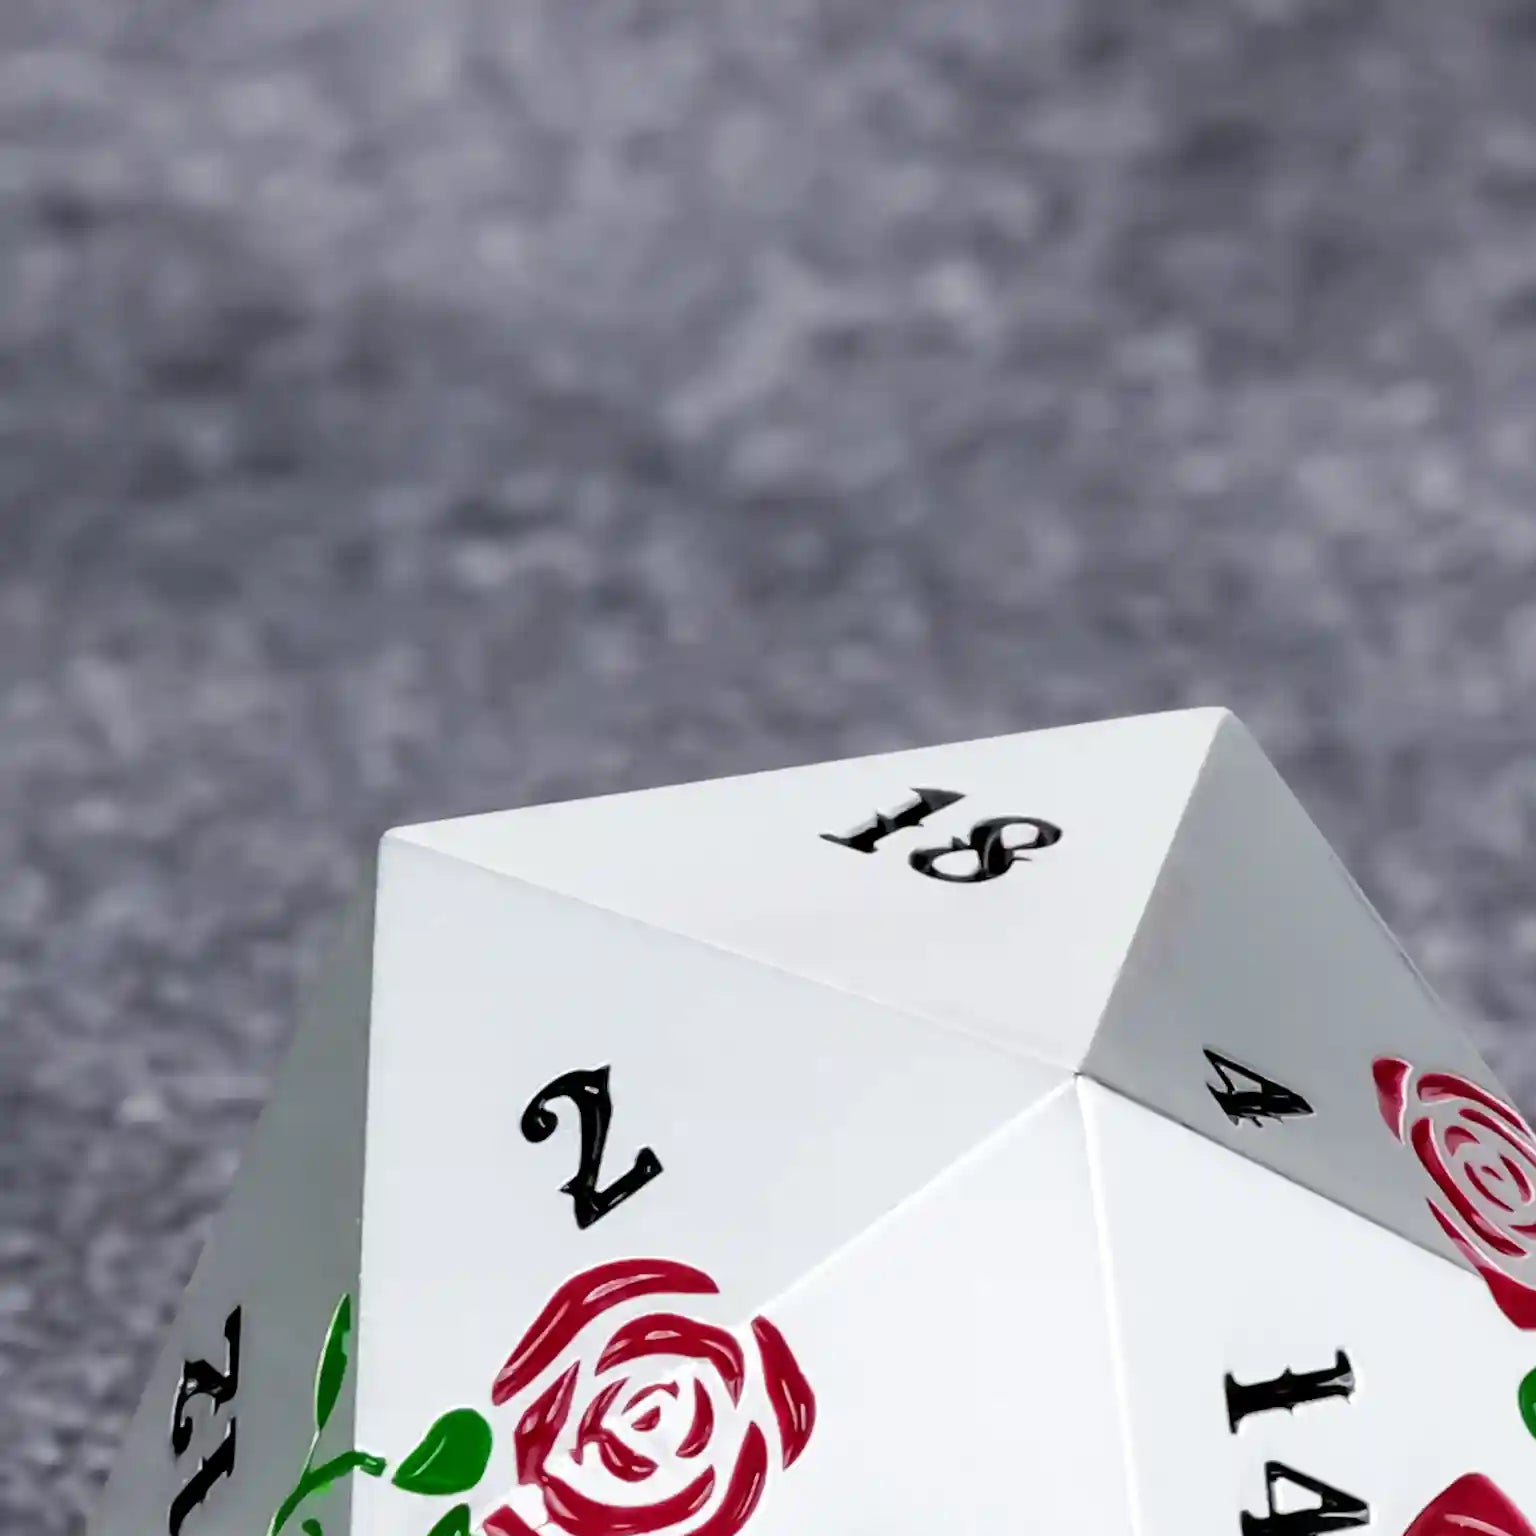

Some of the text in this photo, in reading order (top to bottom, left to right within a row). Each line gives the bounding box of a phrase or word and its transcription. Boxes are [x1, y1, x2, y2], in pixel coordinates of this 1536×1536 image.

[820, 788, 1063, 885] 18
[1202, 1047, 1314, 1128] 4
[520, 1065, 664, 1230] 2
